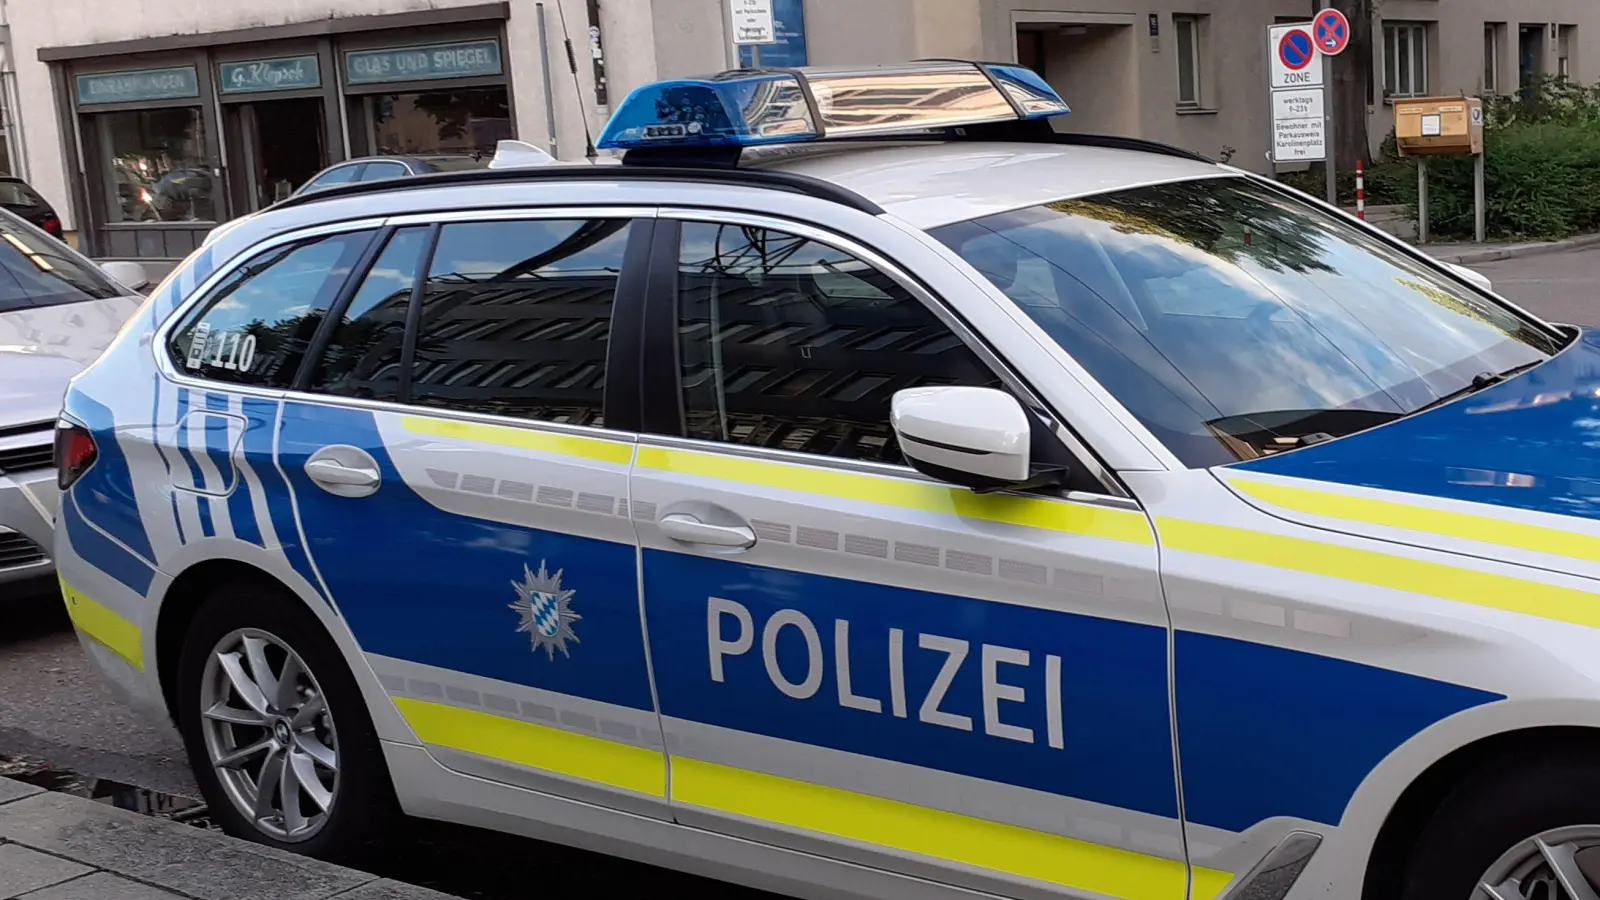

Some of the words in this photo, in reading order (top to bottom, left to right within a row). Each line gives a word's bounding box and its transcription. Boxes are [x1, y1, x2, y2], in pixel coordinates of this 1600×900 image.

[353, 57, 391, 74] GLAS
[396, 53, 429, 71] UND
[433, 48, 492, 68] SPIEGEL
[1283, 72, 1311, 83] ZONE
[1282, 96, 1313, 105] werktags
[1276, 122, 1309, 130] Bewohner
[1310, 121, 1323, 129] mit
[1278, 131, 1320, 139] Parkausweis
[1276, 139, 1323, 148] Karolinenplatz
[1294, 148, 1306, 156] frei
[210, 330, 257, 372] 110
[706, 596, 1065, 751] POLIZEI
